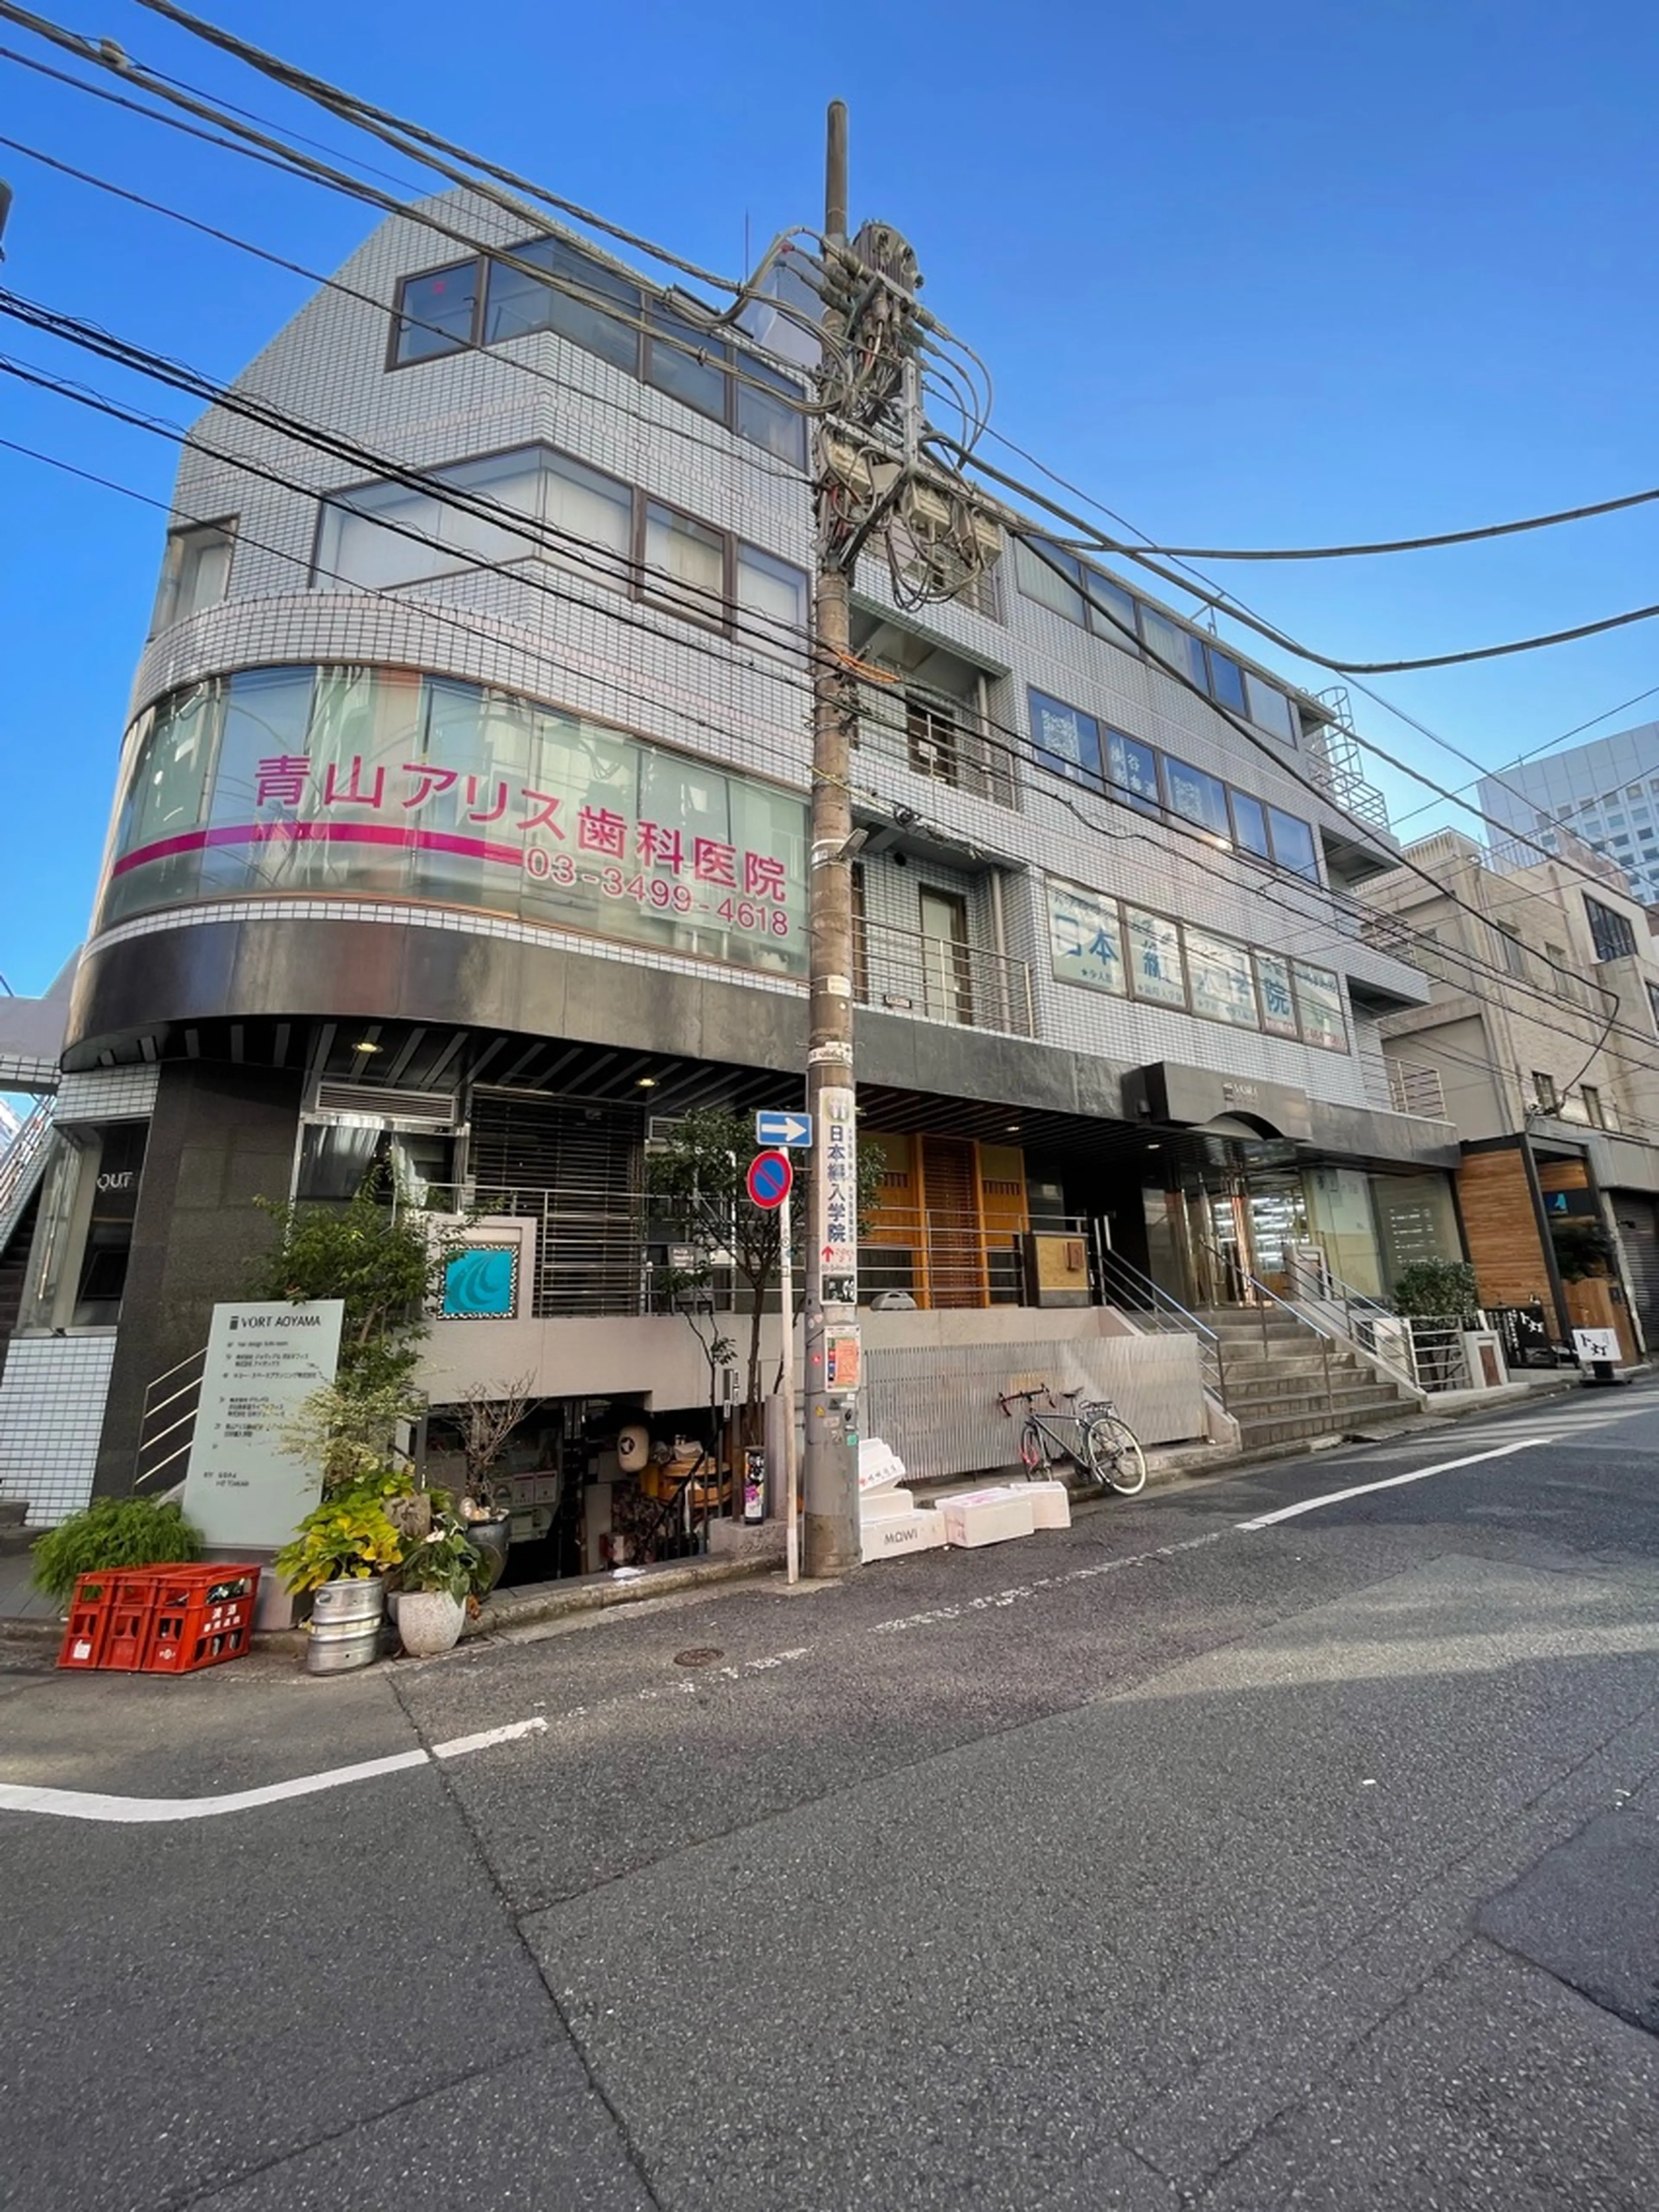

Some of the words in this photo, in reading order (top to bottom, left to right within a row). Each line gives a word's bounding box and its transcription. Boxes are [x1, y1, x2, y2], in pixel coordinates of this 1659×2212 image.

[254, 755, 786, 903] 青山アリス歯科医院
[527, 848, 789, 936] 03-3499-4618
[241, 1316, 273, 1328] VORT
[274, 1316, 321, 1327] AOYAMA
[884, 1527, 918, 1545] MOWI
